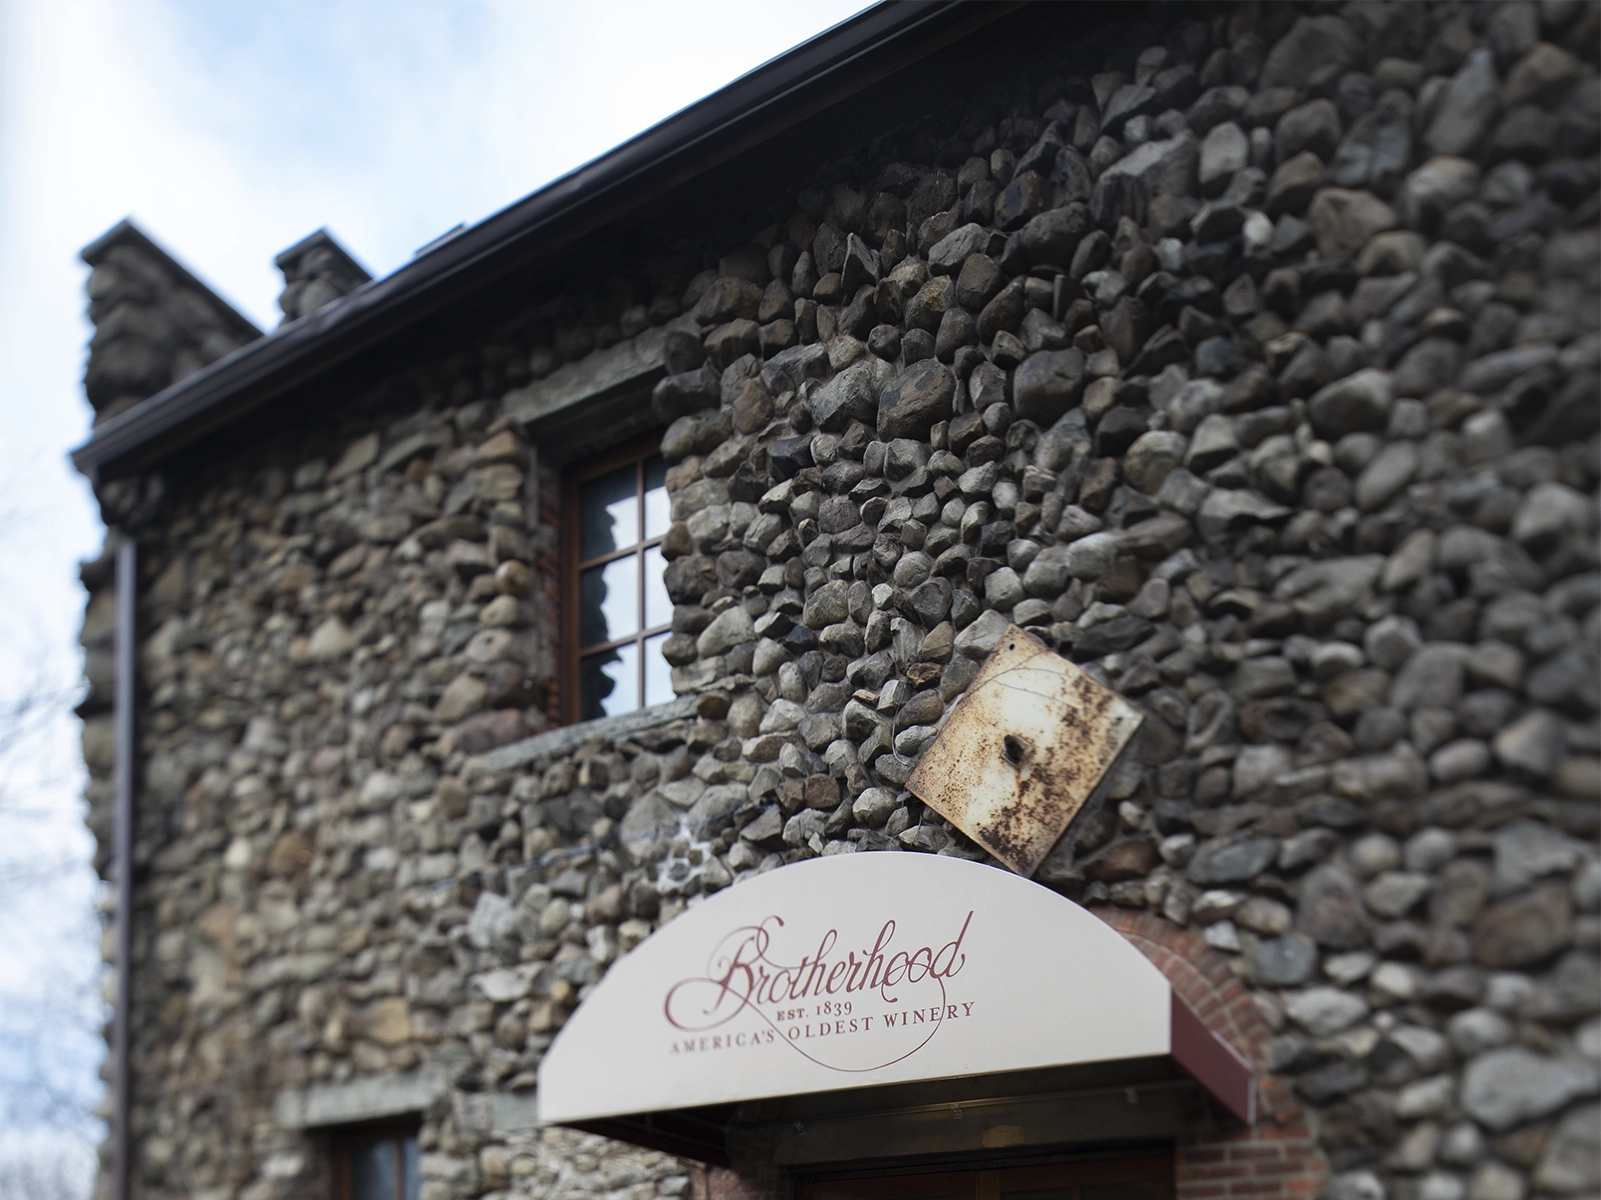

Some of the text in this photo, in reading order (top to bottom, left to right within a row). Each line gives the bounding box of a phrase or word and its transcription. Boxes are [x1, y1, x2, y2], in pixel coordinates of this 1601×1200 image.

[664, 910, 974, 1031] Brotherhood
[669, 1001, 976, 1055] AMERICA'S OLDEST WINERY
[776, 1000, 853, 1021] EST. 1839
